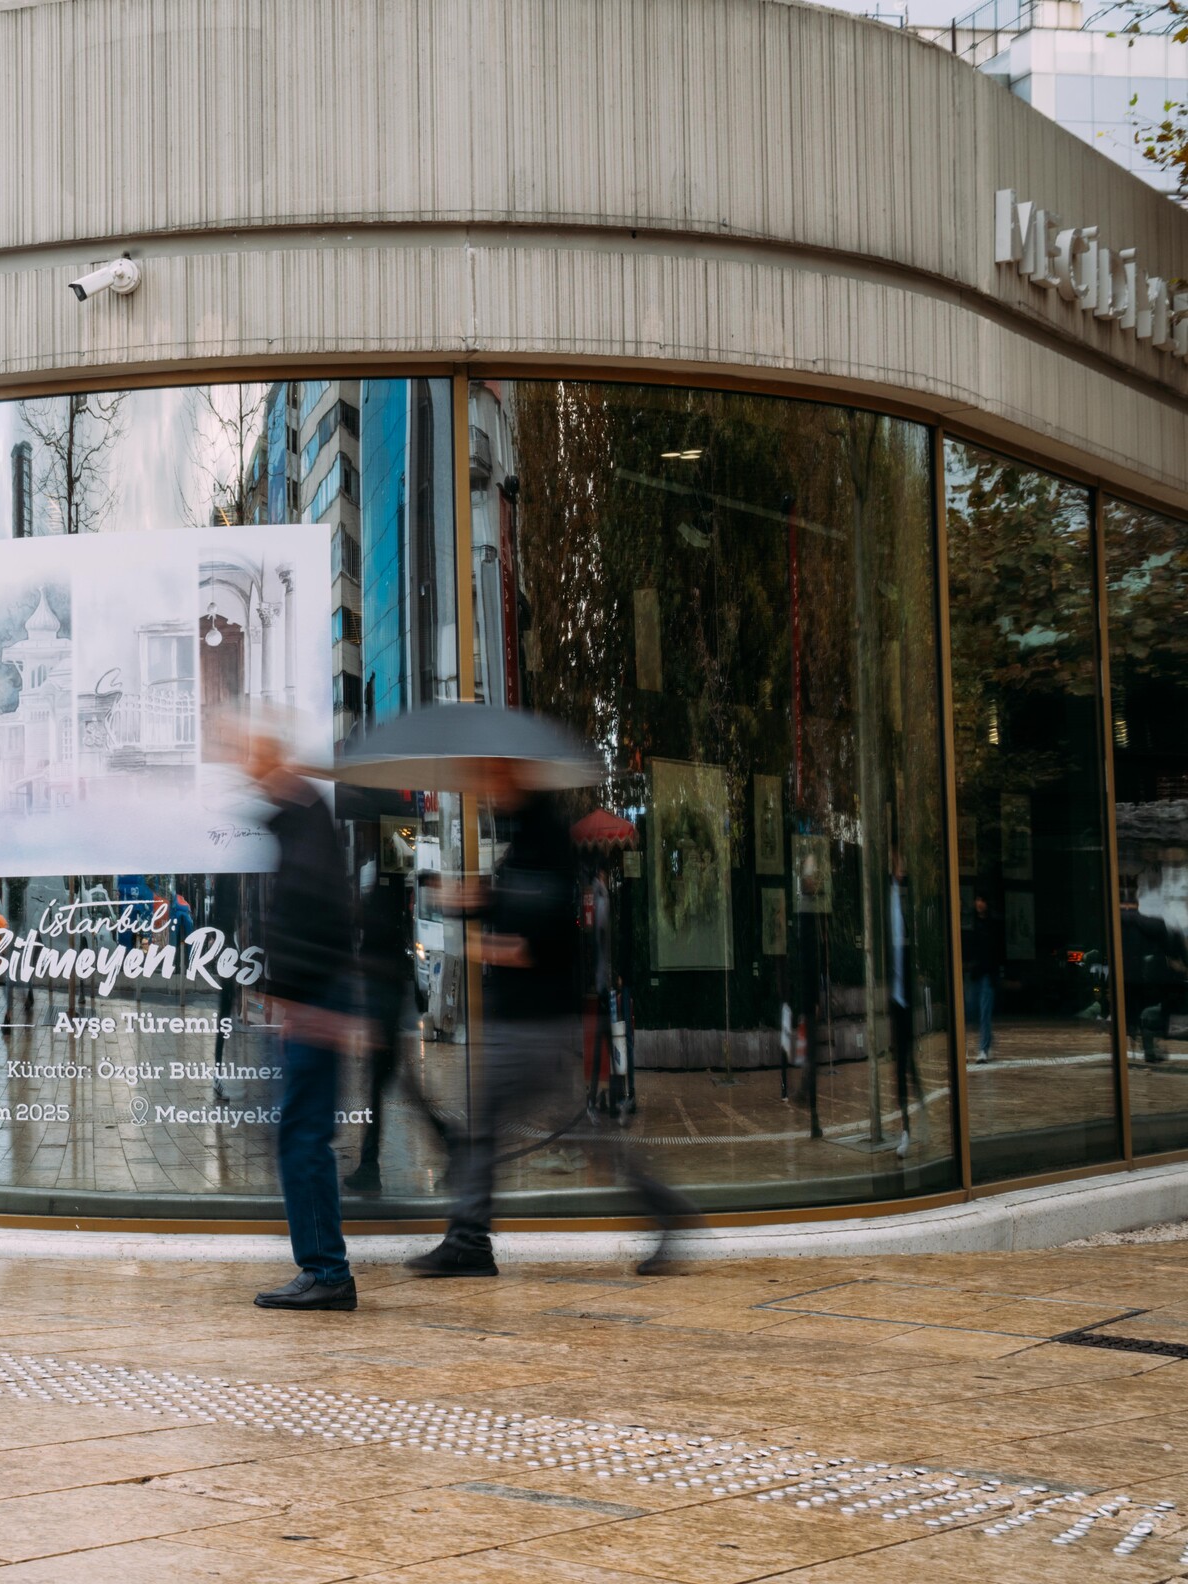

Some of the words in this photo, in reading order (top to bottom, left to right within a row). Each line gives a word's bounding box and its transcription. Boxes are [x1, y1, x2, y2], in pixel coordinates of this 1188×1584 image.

[185, 926, 269, 990] Res
[53, 1012, 116, 1039] Ayşe
[122, 1010, 233, 1038] Türemiş
[7, 1060, 92, 1079] Küratör:
[97, 1056, 164, 1085] Özgür
[169, 1059, 283, 1081] Bükülmez
[16, 1104, 70, 1122] 2025
[155, 1106, 282, 1129] Mecidiyekö
[333, 1108, 373, 1124] nat
